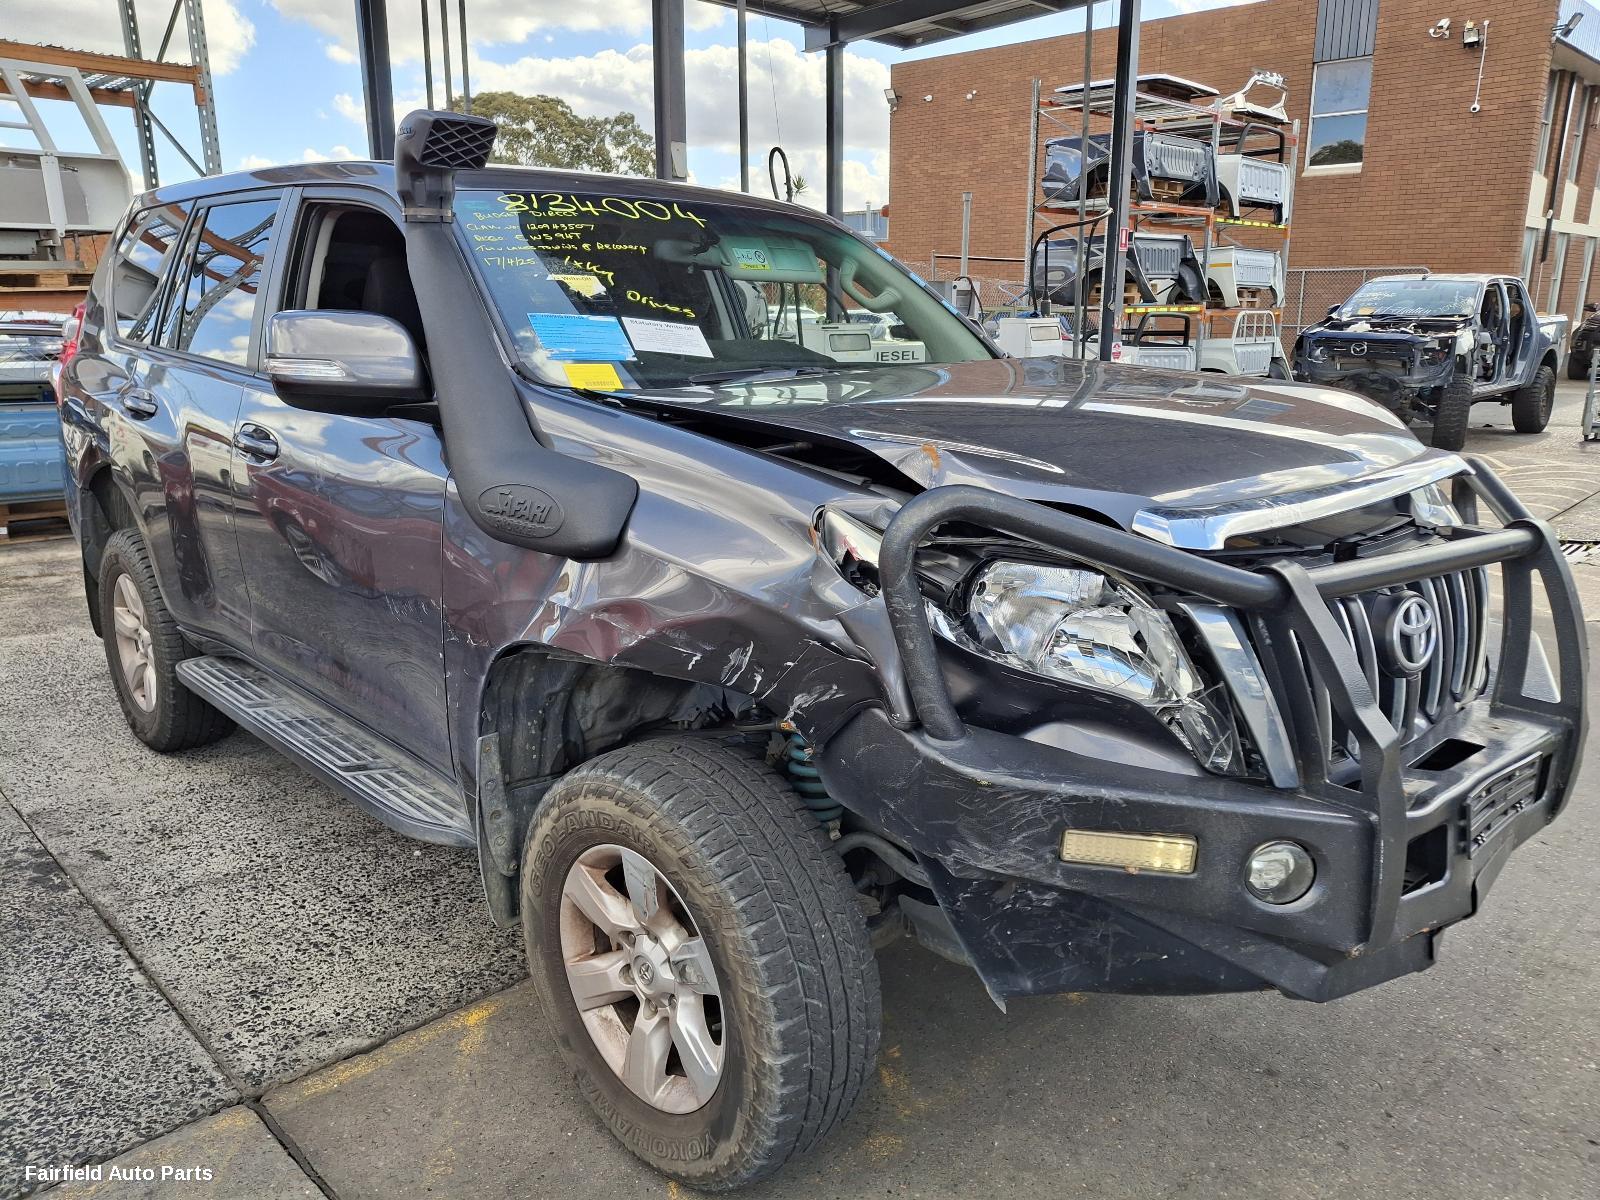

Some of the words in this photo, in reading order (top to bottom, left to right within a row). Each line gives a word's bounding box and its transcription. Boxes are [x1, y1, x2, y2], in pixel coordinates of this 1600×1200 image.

[473, 211, 521, 221] BUDGET
[497, 193, 708, 228] 8134004
[484, 256, 537, 270] 17/4/25
[626, 290, 696, 318] Drives
[629, 319, 663, 329] Statutory
[664, 322, 695, 331] Write-Off
[485, 488, 553, 525] SAFARI
